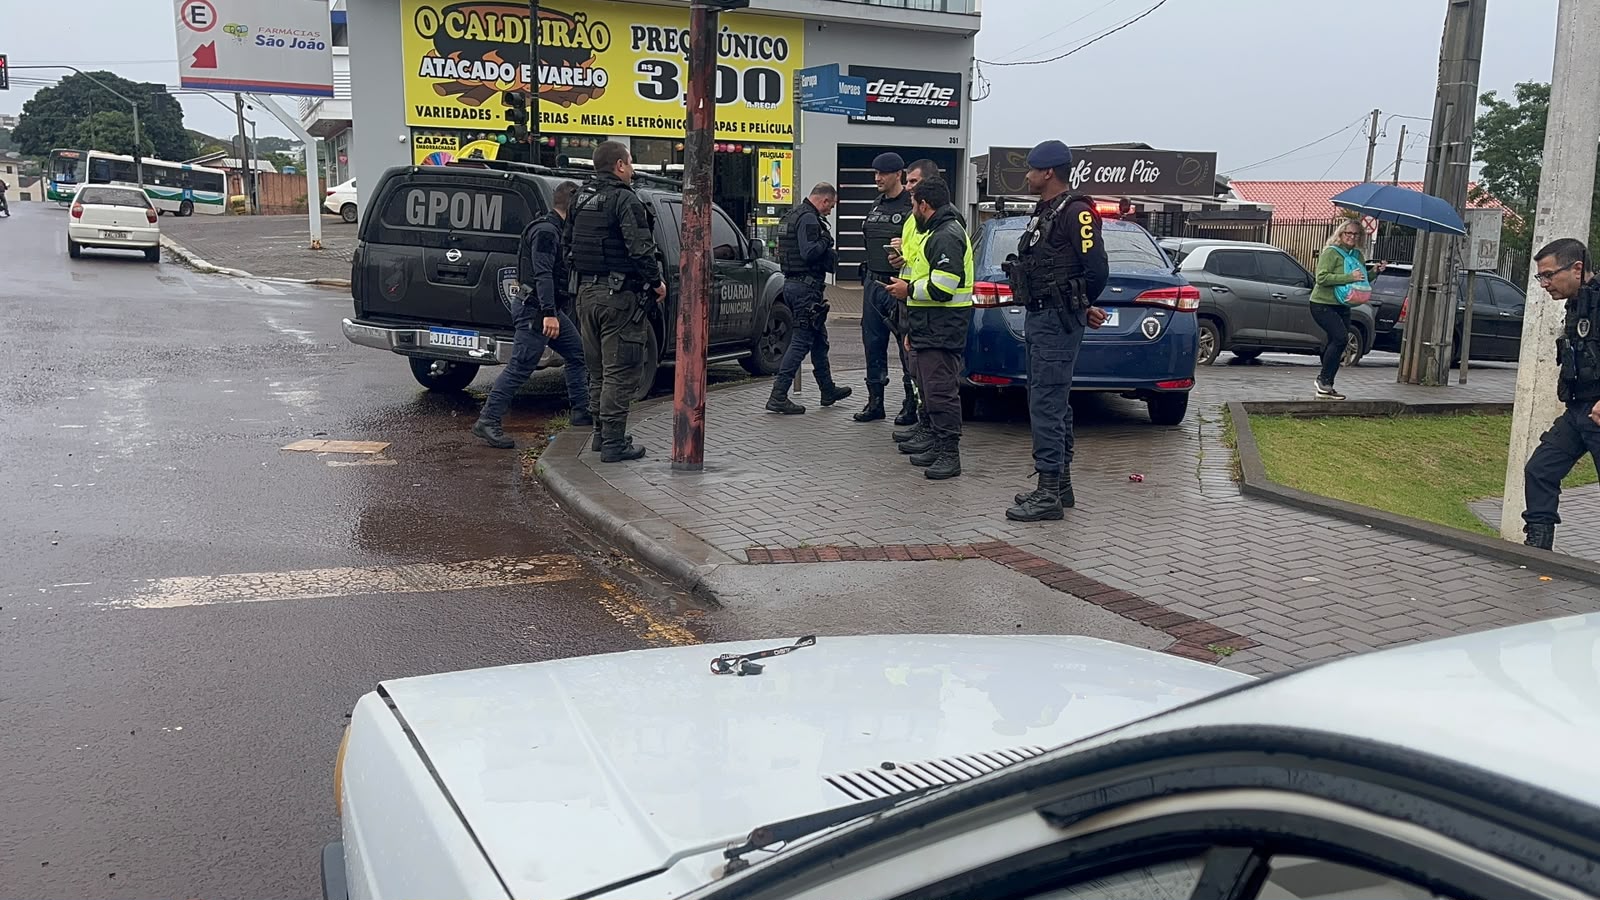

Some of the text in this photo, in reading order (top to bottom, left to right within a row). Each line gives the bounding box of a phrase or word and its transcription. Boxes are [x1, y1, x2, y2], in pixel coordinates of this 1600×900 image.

[190, 5, 207, 25] E
[416, 8, 610, 50] O CALDEIRÃO
[255, 35, 325, 51] São João
[631, 26, 788, 61] PREÇ ÚNICO
[420, 57, 608, 88] ATACADO E VAREJO
[838, 81, 861, 96] Moraes
[866, 79, 955, 99] detalhe
[877, 95, 950, 107] automotivo
[415, 105, 492, 121] VARIEDADES
[581, 114, 614, 127] MEIAS
[715, 120, 738, 133] APAS
[741, 121, 746, 133] E
[415, 136, 457, 145] CAPAS
[948, 136, 959, 144] 351
[1094, 166, 1127, 183] com
[1129, 159, 1161, 183] Pão
[405, 188, 503, 231] GPOM
[721, 284, 754, 300] GUARDA
[720, 301, 753, 315] MUNICIPAL
